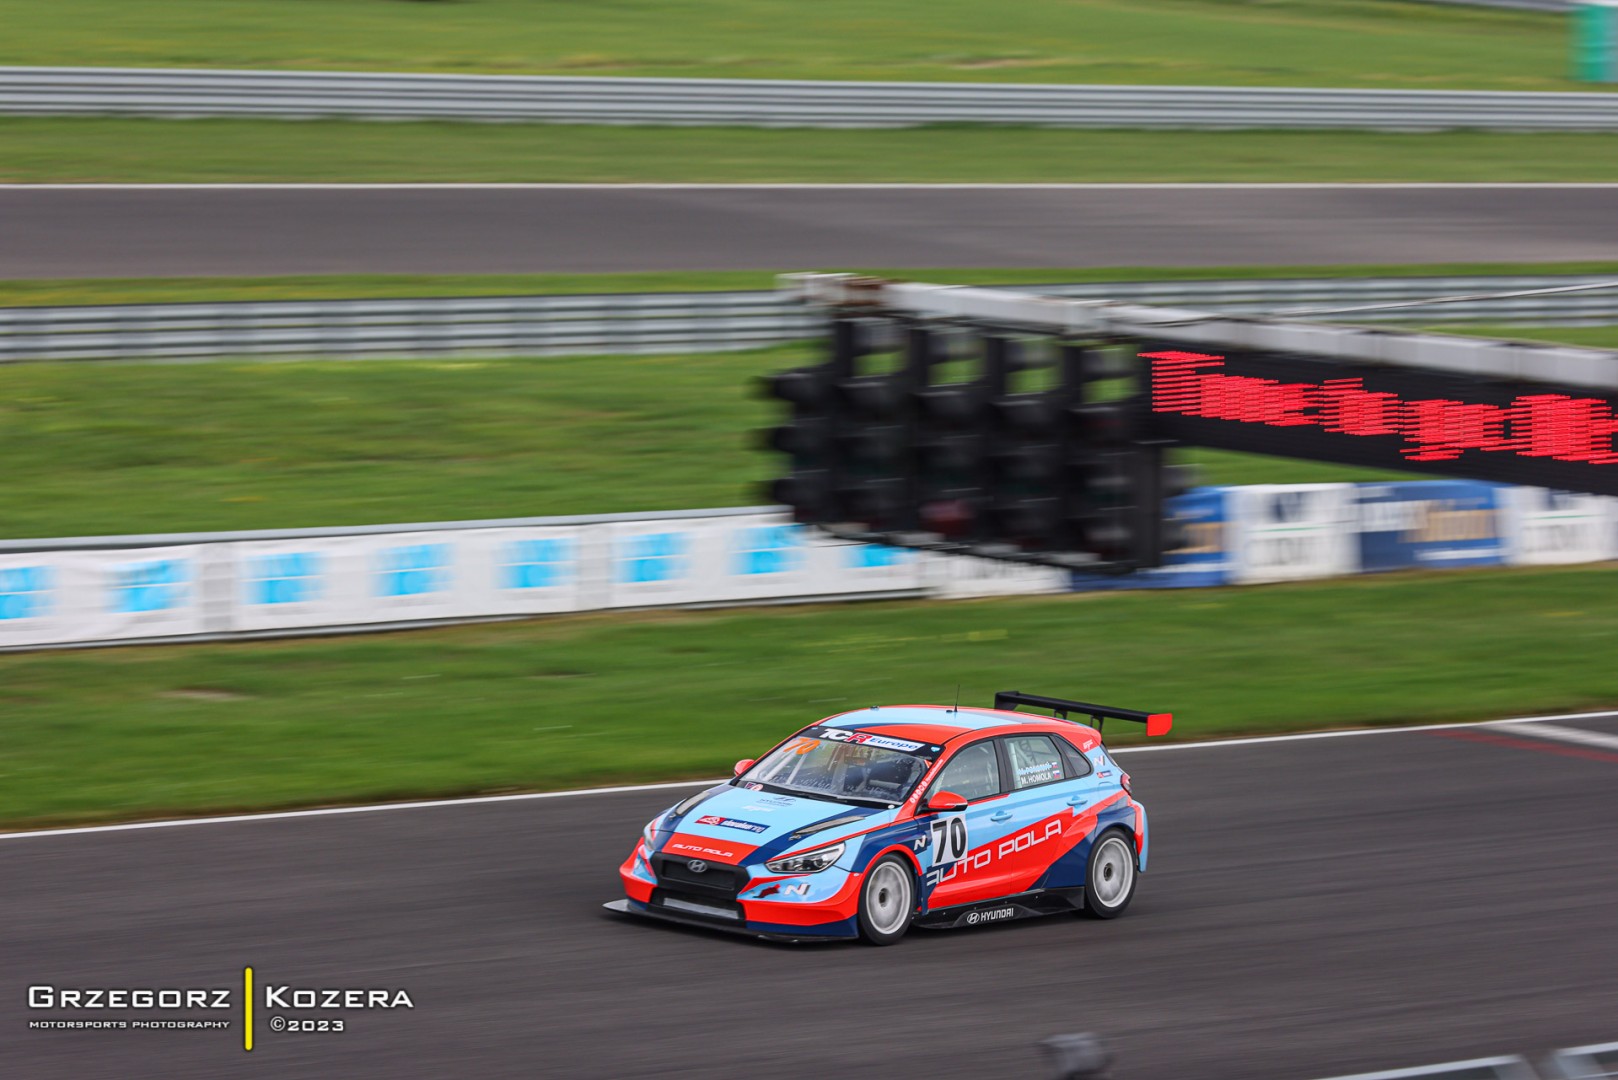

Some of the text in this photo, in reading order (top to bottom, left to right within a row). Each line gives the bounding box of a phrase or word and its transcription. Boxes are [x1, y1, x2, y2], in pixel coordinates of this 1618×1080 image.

[783, 737, 821, 755] 70
[820, 728, 918, 750] TCR Europe
[672, 843, 734, 857] AUTO POLA
[932, 817, 967, 864] 70
[926, 819, 1062, 886] AUTO POLA
[980, 907, 1014, 922] HYUNDAI
